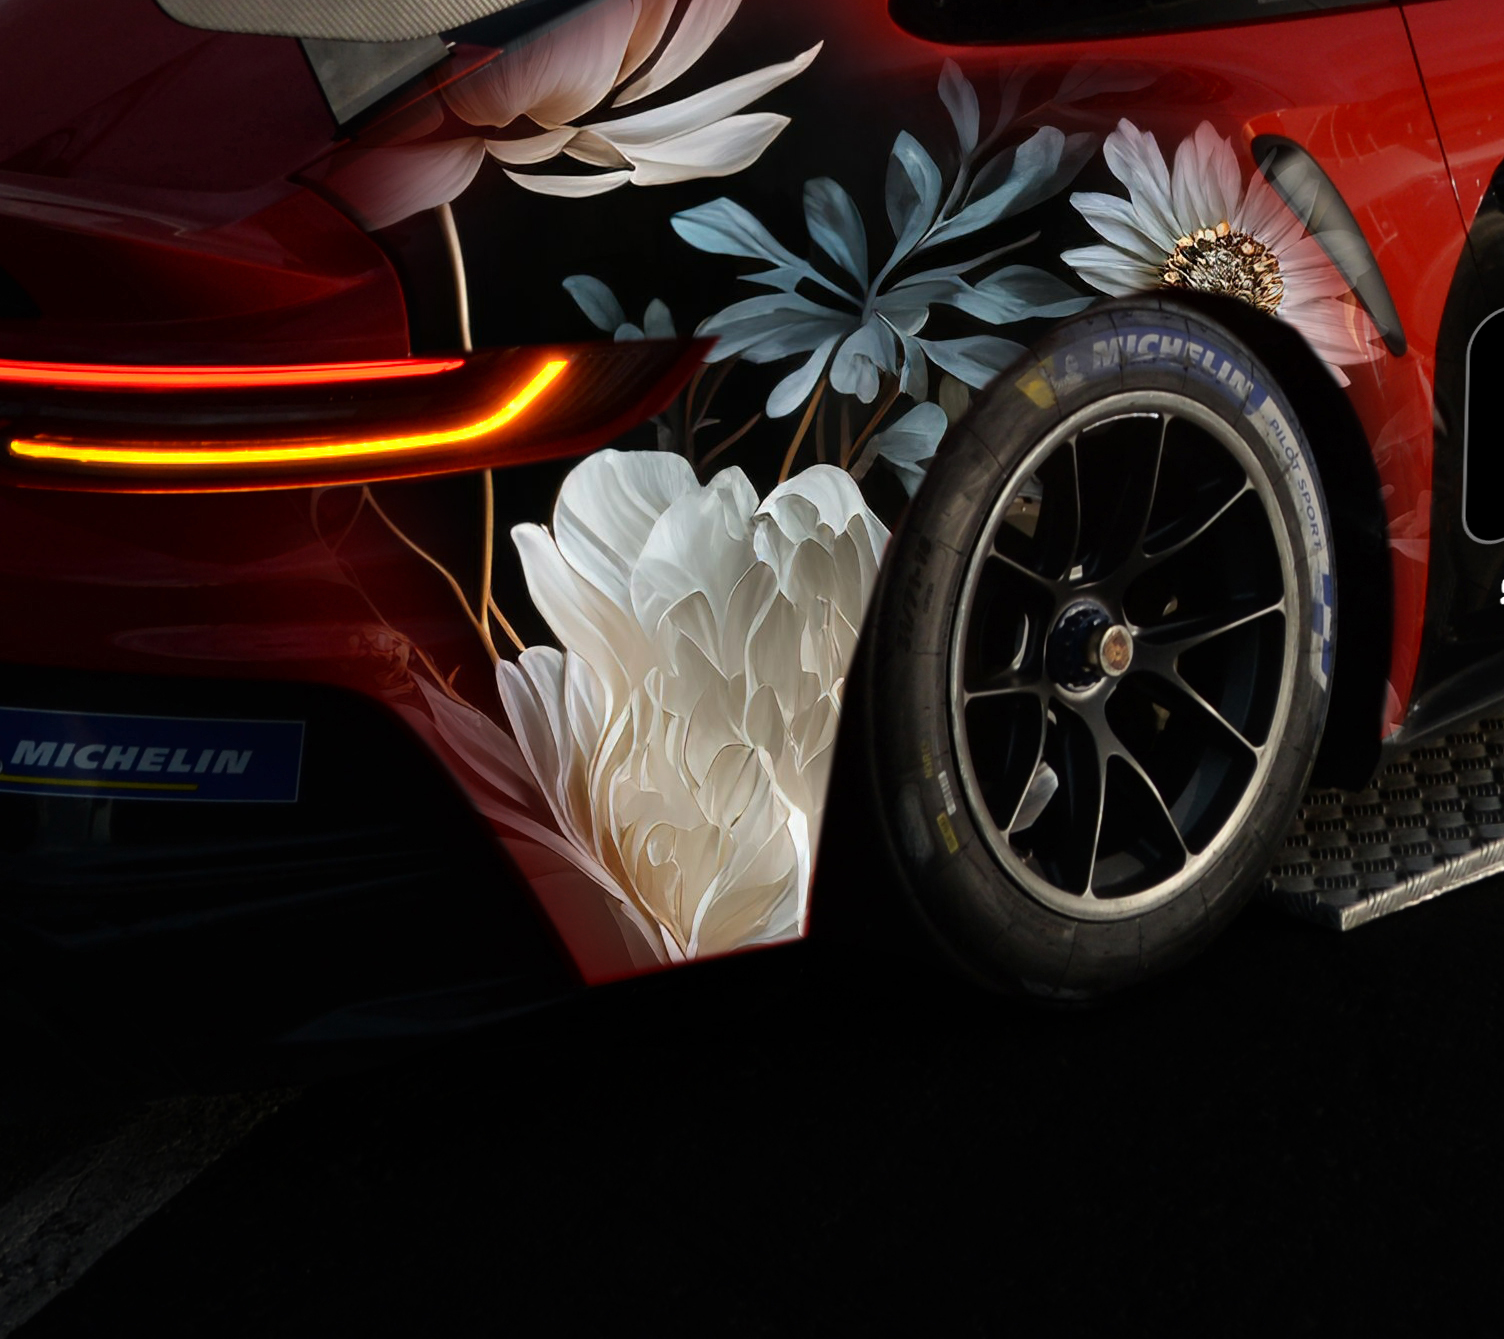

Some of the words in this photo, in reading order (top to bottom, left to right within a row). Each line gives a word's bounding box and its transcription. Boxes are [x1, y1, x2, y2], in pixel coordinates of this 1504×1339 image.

[1093, 334, 1254, 403] MICHELIN
[1270, 419, 1300, 471] PILOT
[1298, 479, 1322, 550] SPORT
[10, 740, 253, 774] MICHELIN
